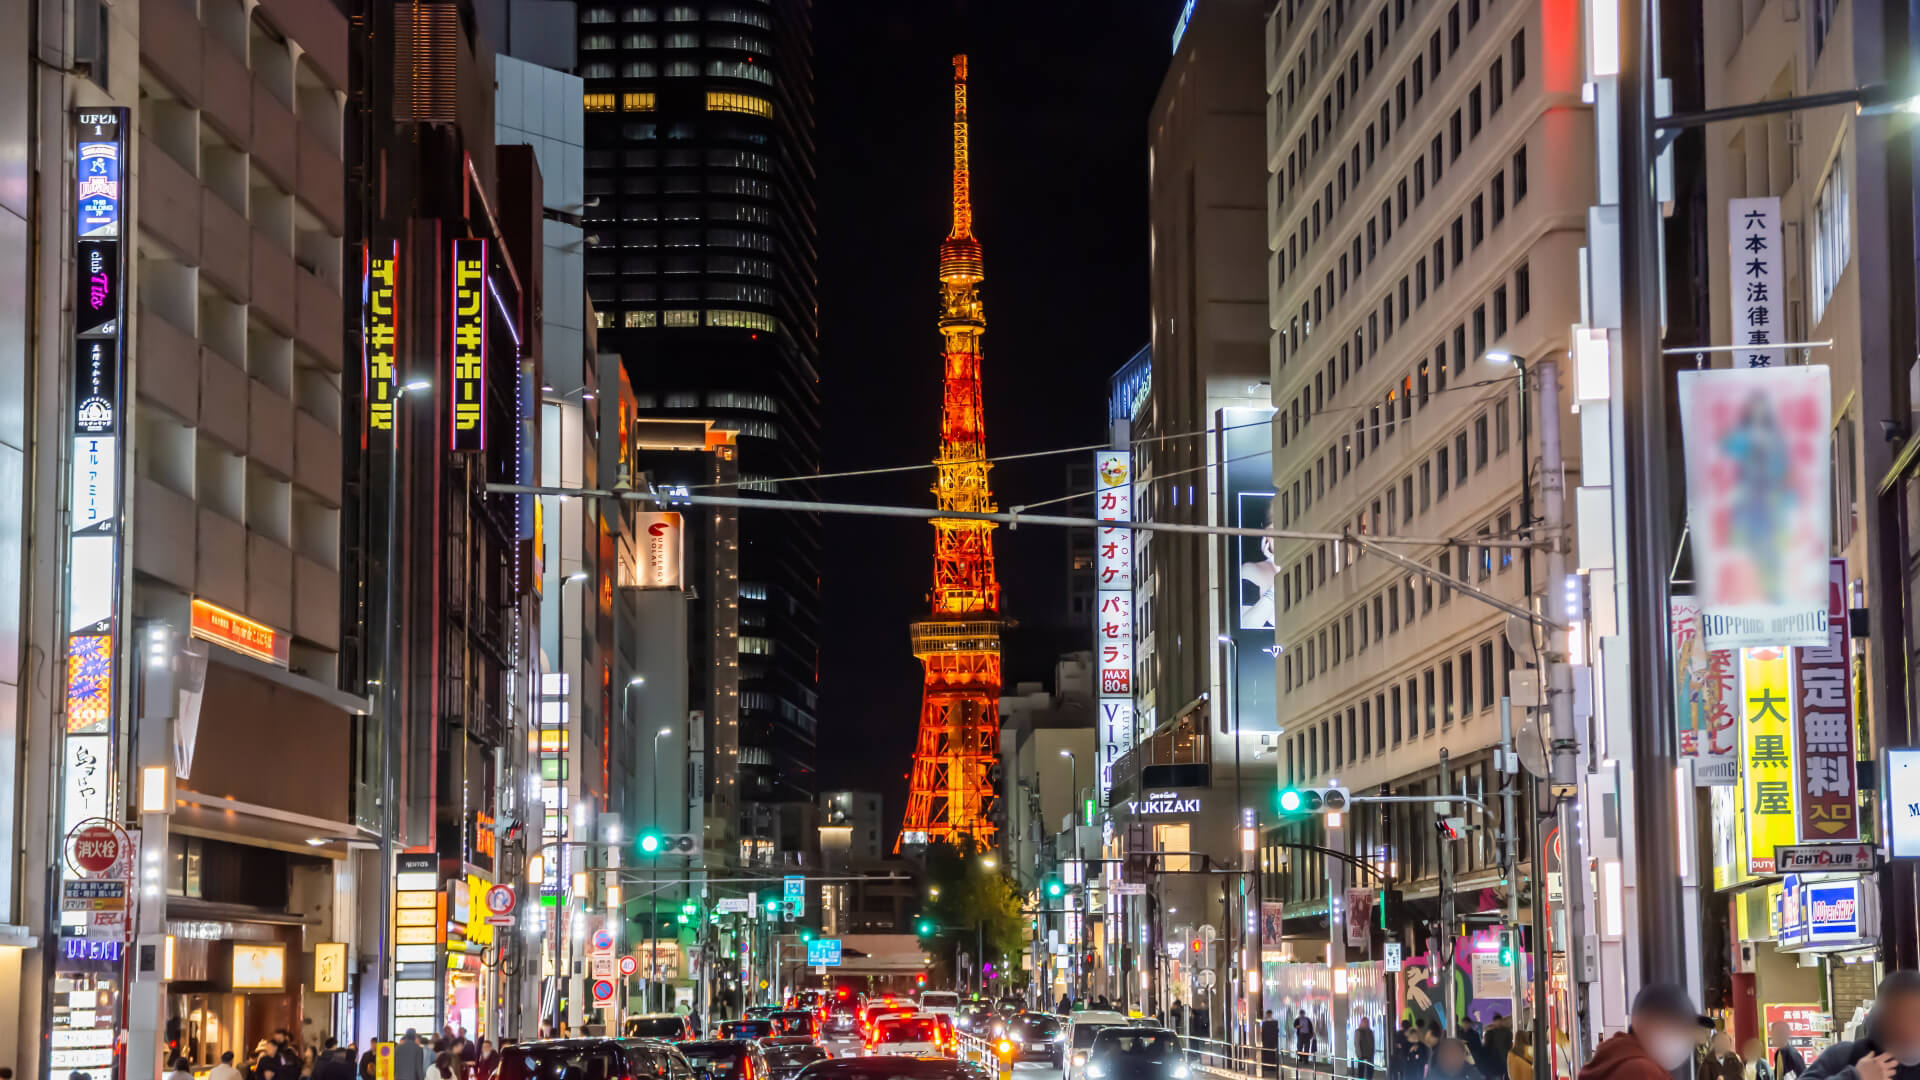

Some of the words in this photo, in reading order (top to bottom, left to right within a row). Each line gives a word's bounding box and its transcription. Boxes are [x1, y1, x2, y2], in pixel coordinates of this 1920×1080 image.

[91, 251, 103, 273] club
[1120, 496, 1129, 580] KAAOKE
[1101, 596, 1121, 664] パセラ
[1104, 671, 1127, 680] MAX
[1103, 703, 1120, 763] VIP
[1750, 688, 1792, 815] 大黒屋
[1128, 800, 1201, 815] YUKIZAKI
[1809, 803, 1851, 821] 入口
[78, 840, 116, 858] 消火栓
[1752, 861, 1775, 869] DUTY
[623, 961, 633, 970] 40
